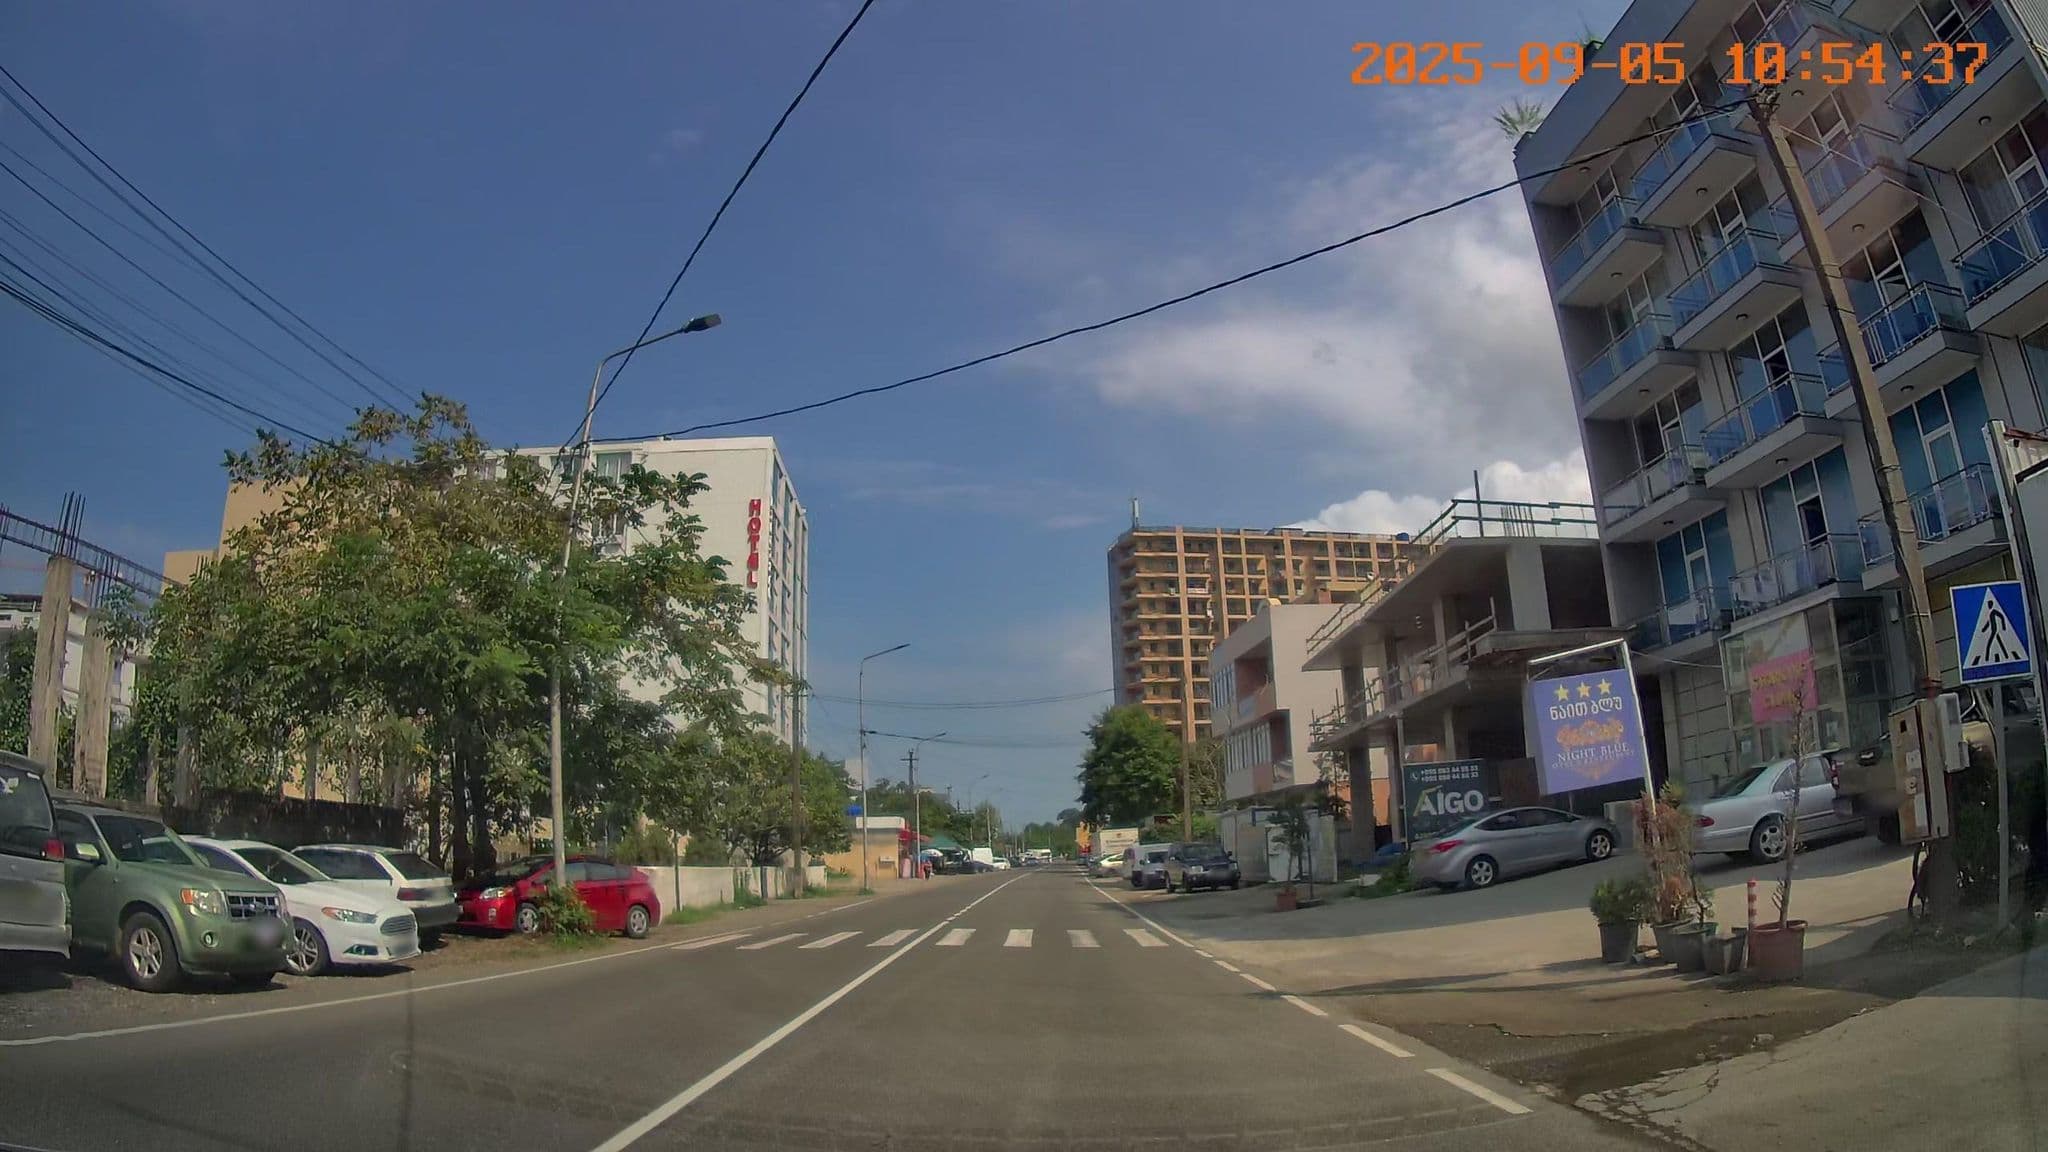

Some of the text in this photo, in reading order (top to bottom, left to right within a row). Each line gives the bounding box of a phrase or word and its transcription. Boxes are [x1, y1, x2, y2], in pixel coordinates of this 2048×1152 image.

[746, 499, 762, 589] HOTEL
[1549, 696, 1623, 720] ნაით ბლუ
[1557, 747, 1597, 762] NIGHT
[1600, 742, 1630, 756] BLUE
[1413, 786, 1484, 817] AIGO
